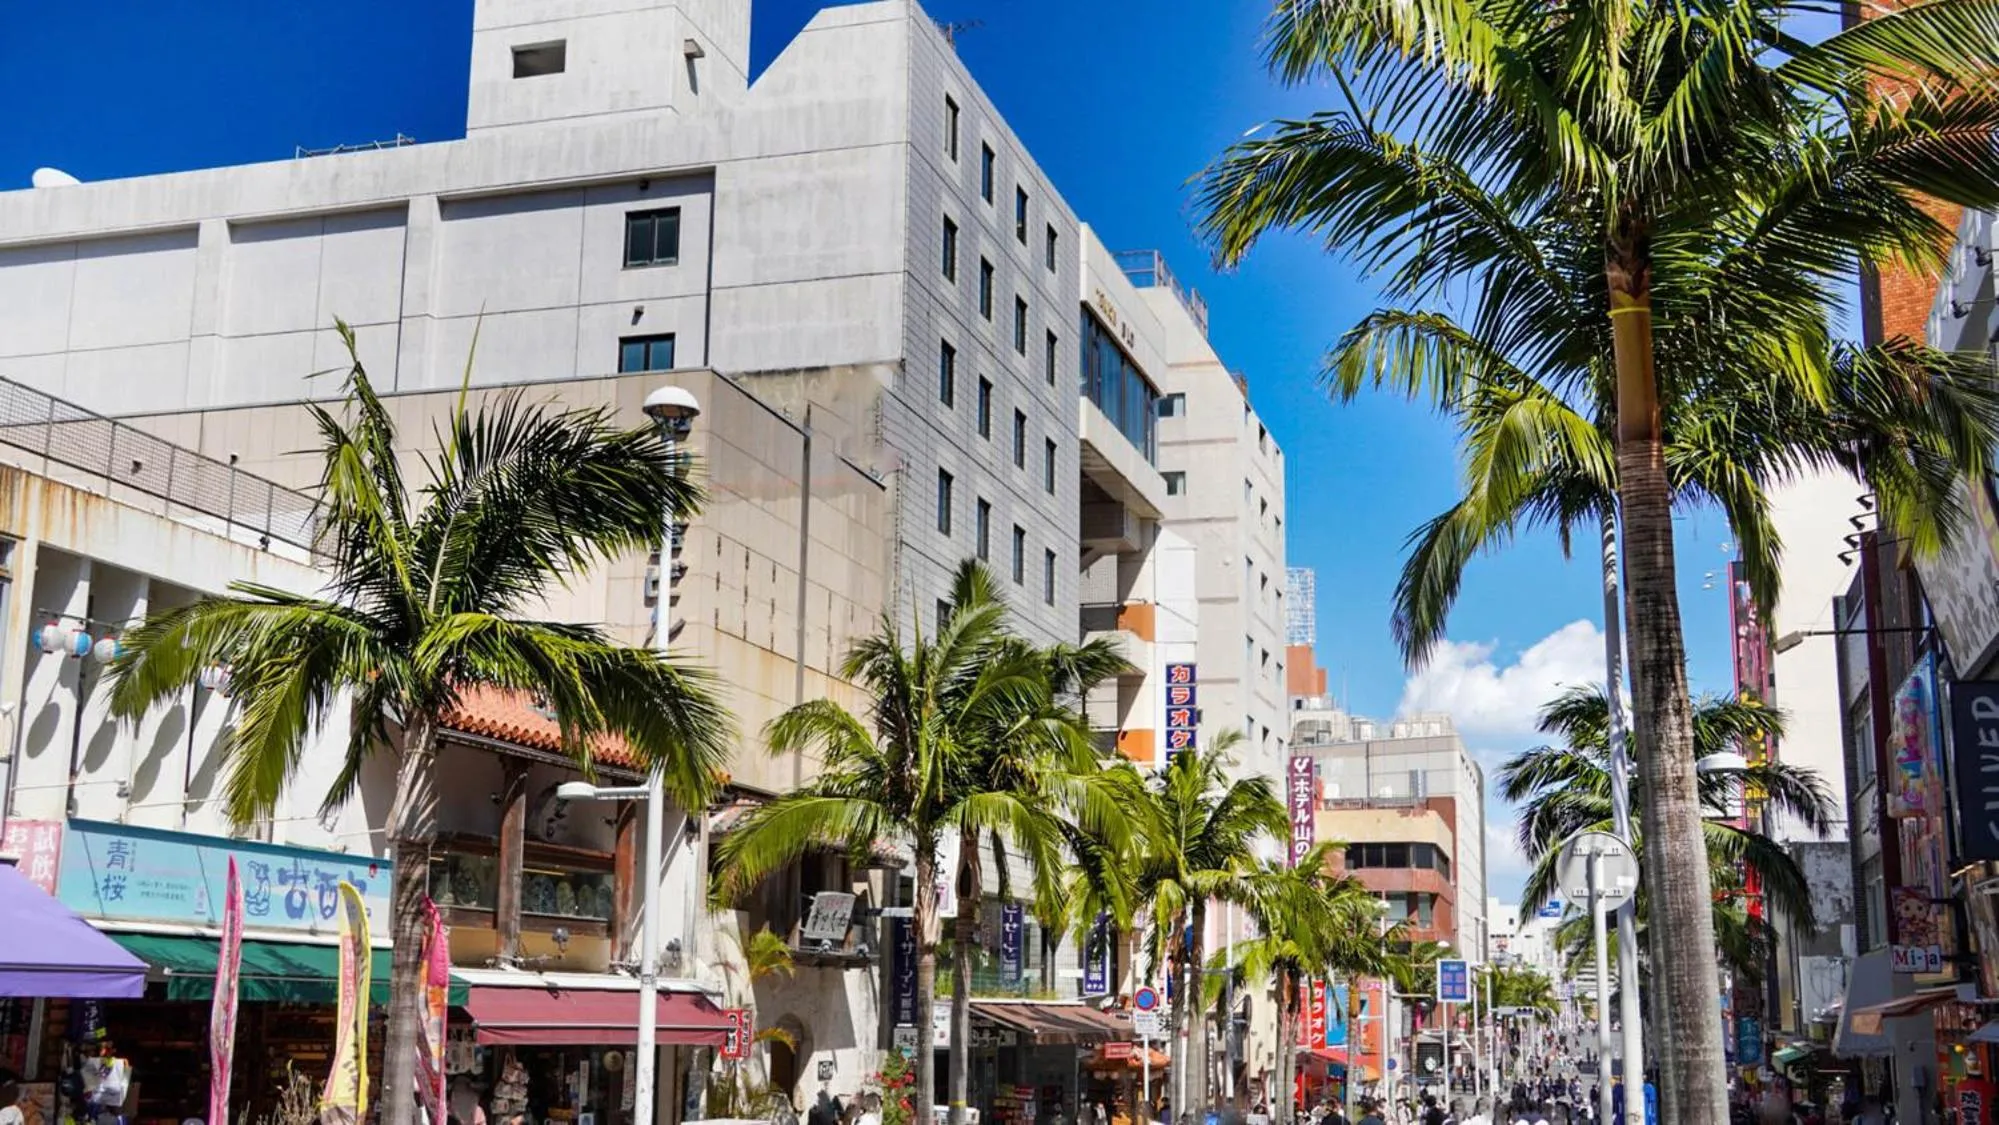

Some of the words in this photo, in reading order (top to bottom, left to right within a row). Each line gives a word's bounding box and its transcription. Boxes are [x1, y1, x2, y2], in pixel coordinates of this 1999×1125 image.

[1170, 665, 1190, 749] カラオケ
[31, 826, 55, 891] 試飲
